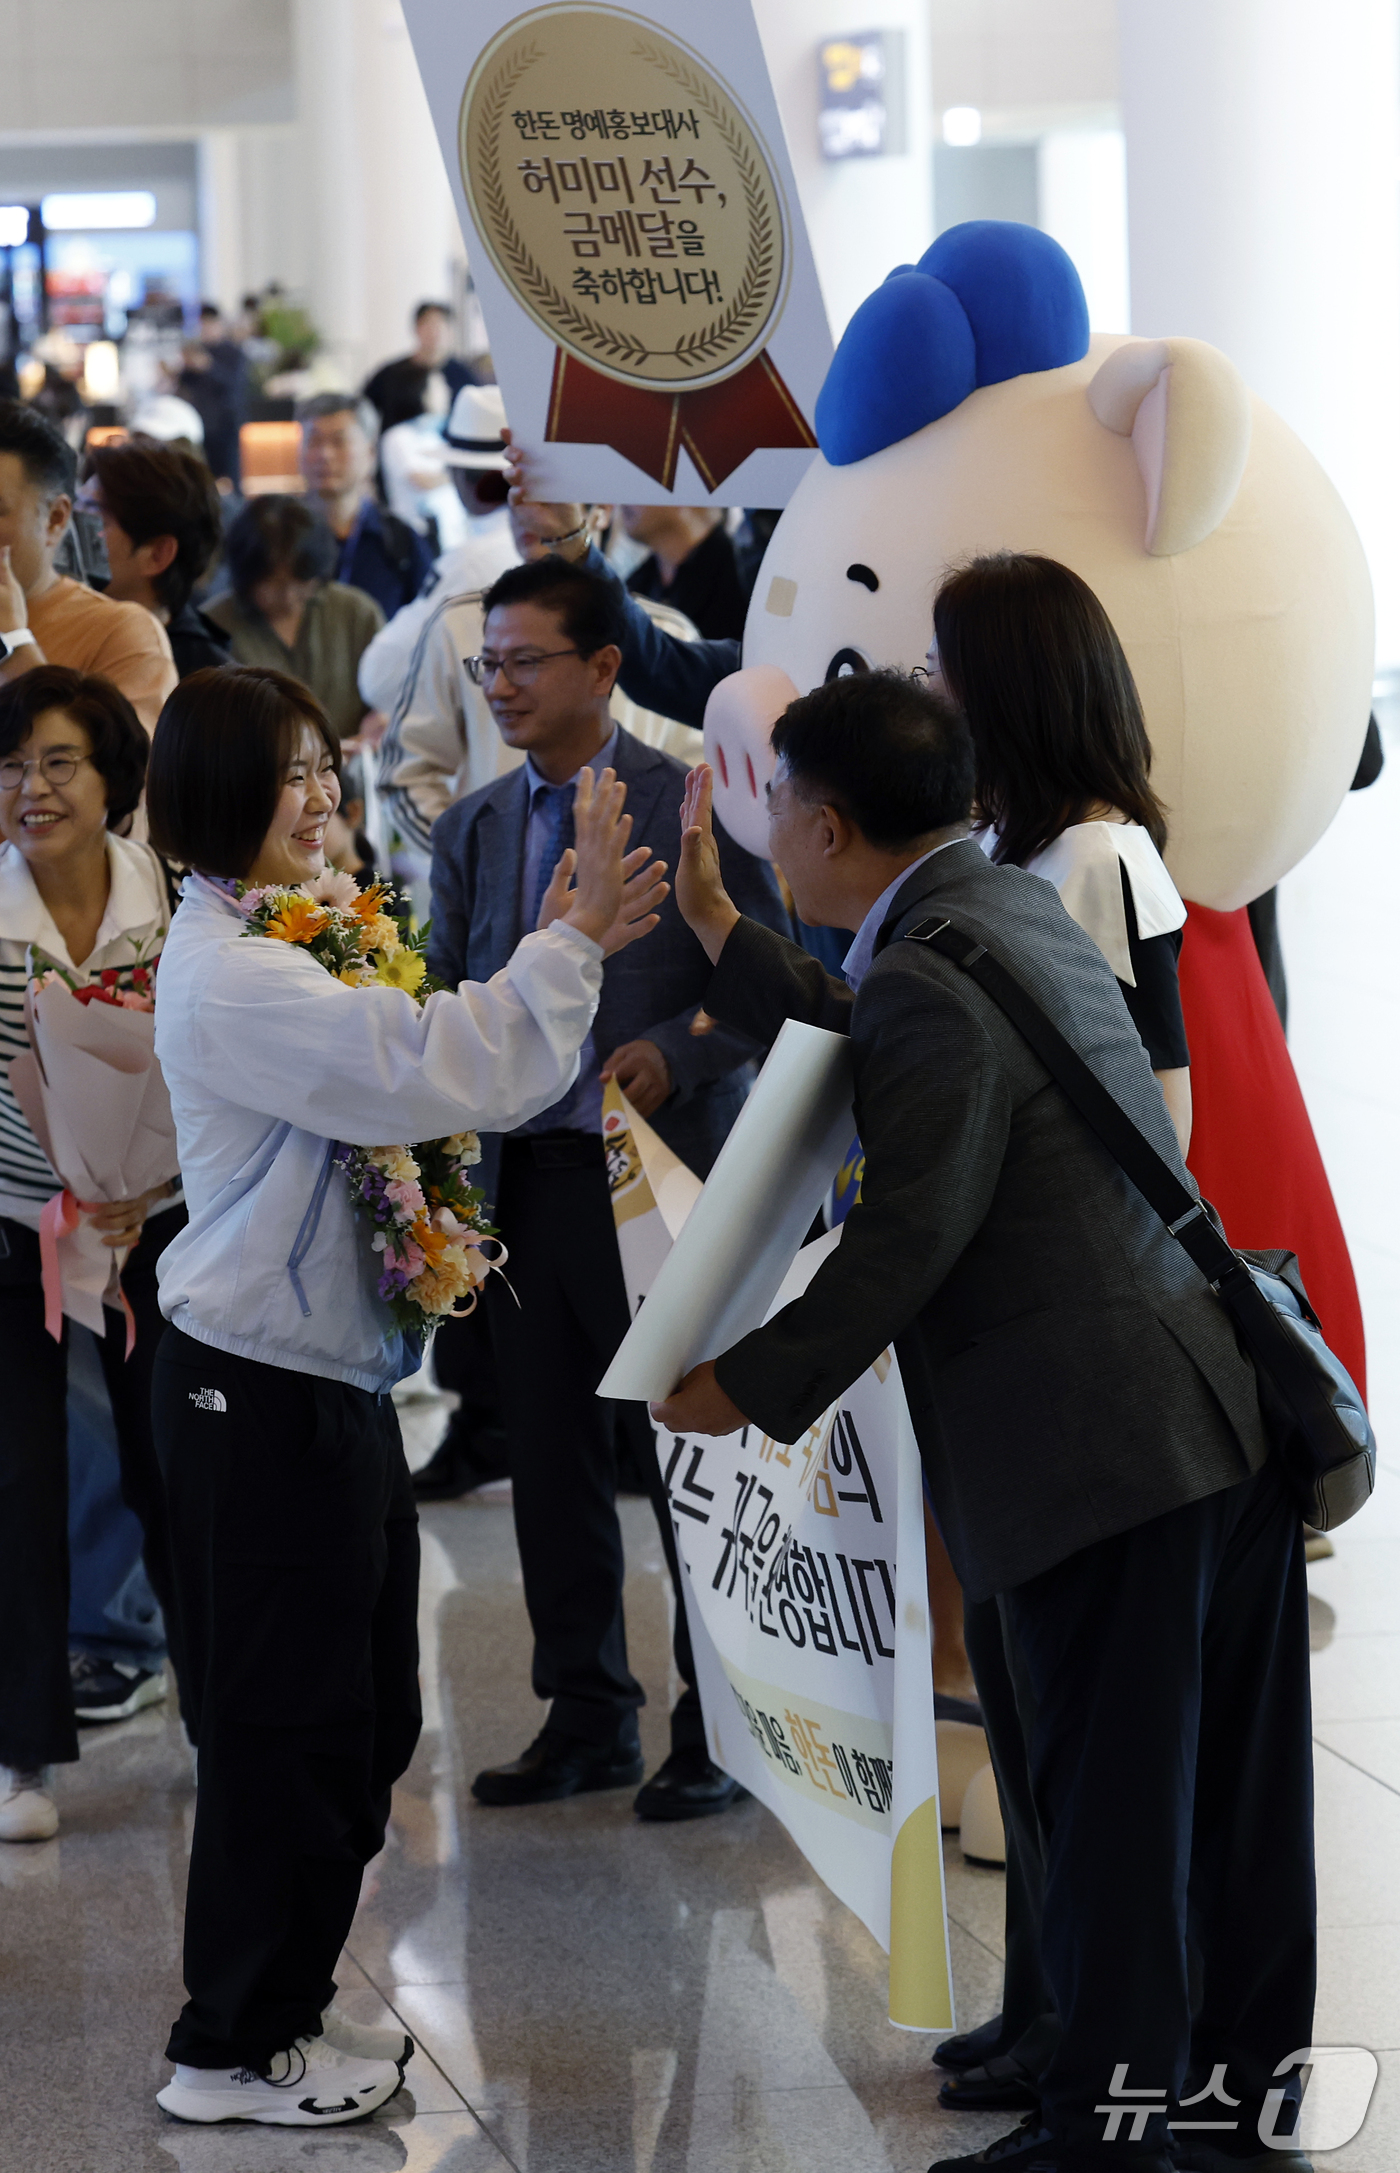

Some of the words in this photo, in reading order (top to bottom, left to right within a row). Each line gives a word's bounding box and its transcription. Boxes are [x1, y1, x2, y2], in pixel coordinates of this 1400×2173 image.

[511, 109, 560, 141] 한돈
[560, 108, 700, 141] 명예홍보대사
[517, 154, 635, 204] 허미미
[639, 154, 727, 208] 선수,
[563, 208, 705, 258] 금메달을
[572, 266, 723, 304] 축하합니다!
[188, 1392, 214, 1403] NORTH
[194, 1401, 213, 1411] FACE
[199, 1387, 214, 1397] THE
[784, 1708, 862, 1806] 한돈이
